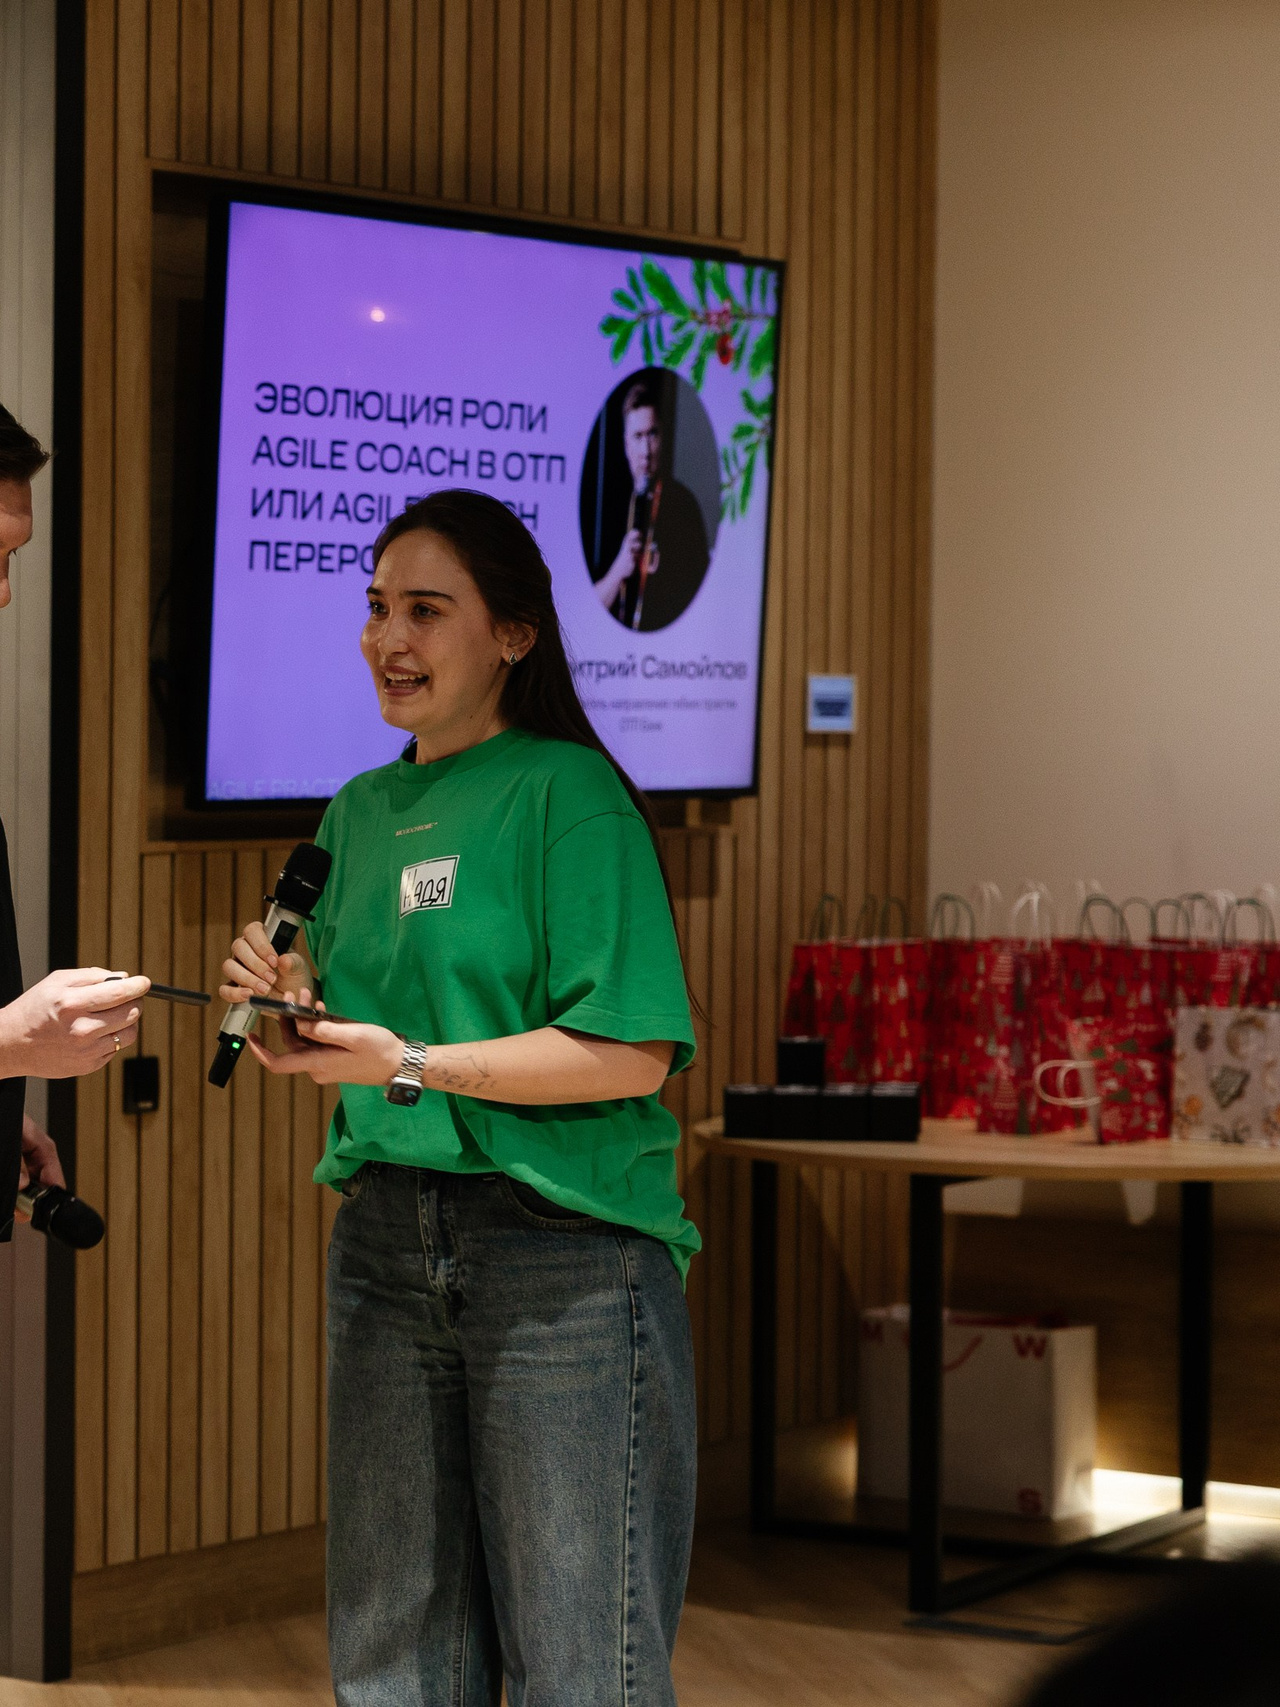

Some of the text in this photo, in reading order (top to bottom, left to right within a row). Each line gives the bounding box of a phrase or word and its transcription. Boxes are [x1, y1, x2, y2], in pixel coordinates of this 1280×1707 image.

[254, 381, 548, 433] ЭВОЛЮЦИЯ РОЛИ
[251, 435, 348, 471] AGILE
[356, 441, 470, 478] COACH
[250, 487, 424, 524] ИЛИ AGIL
